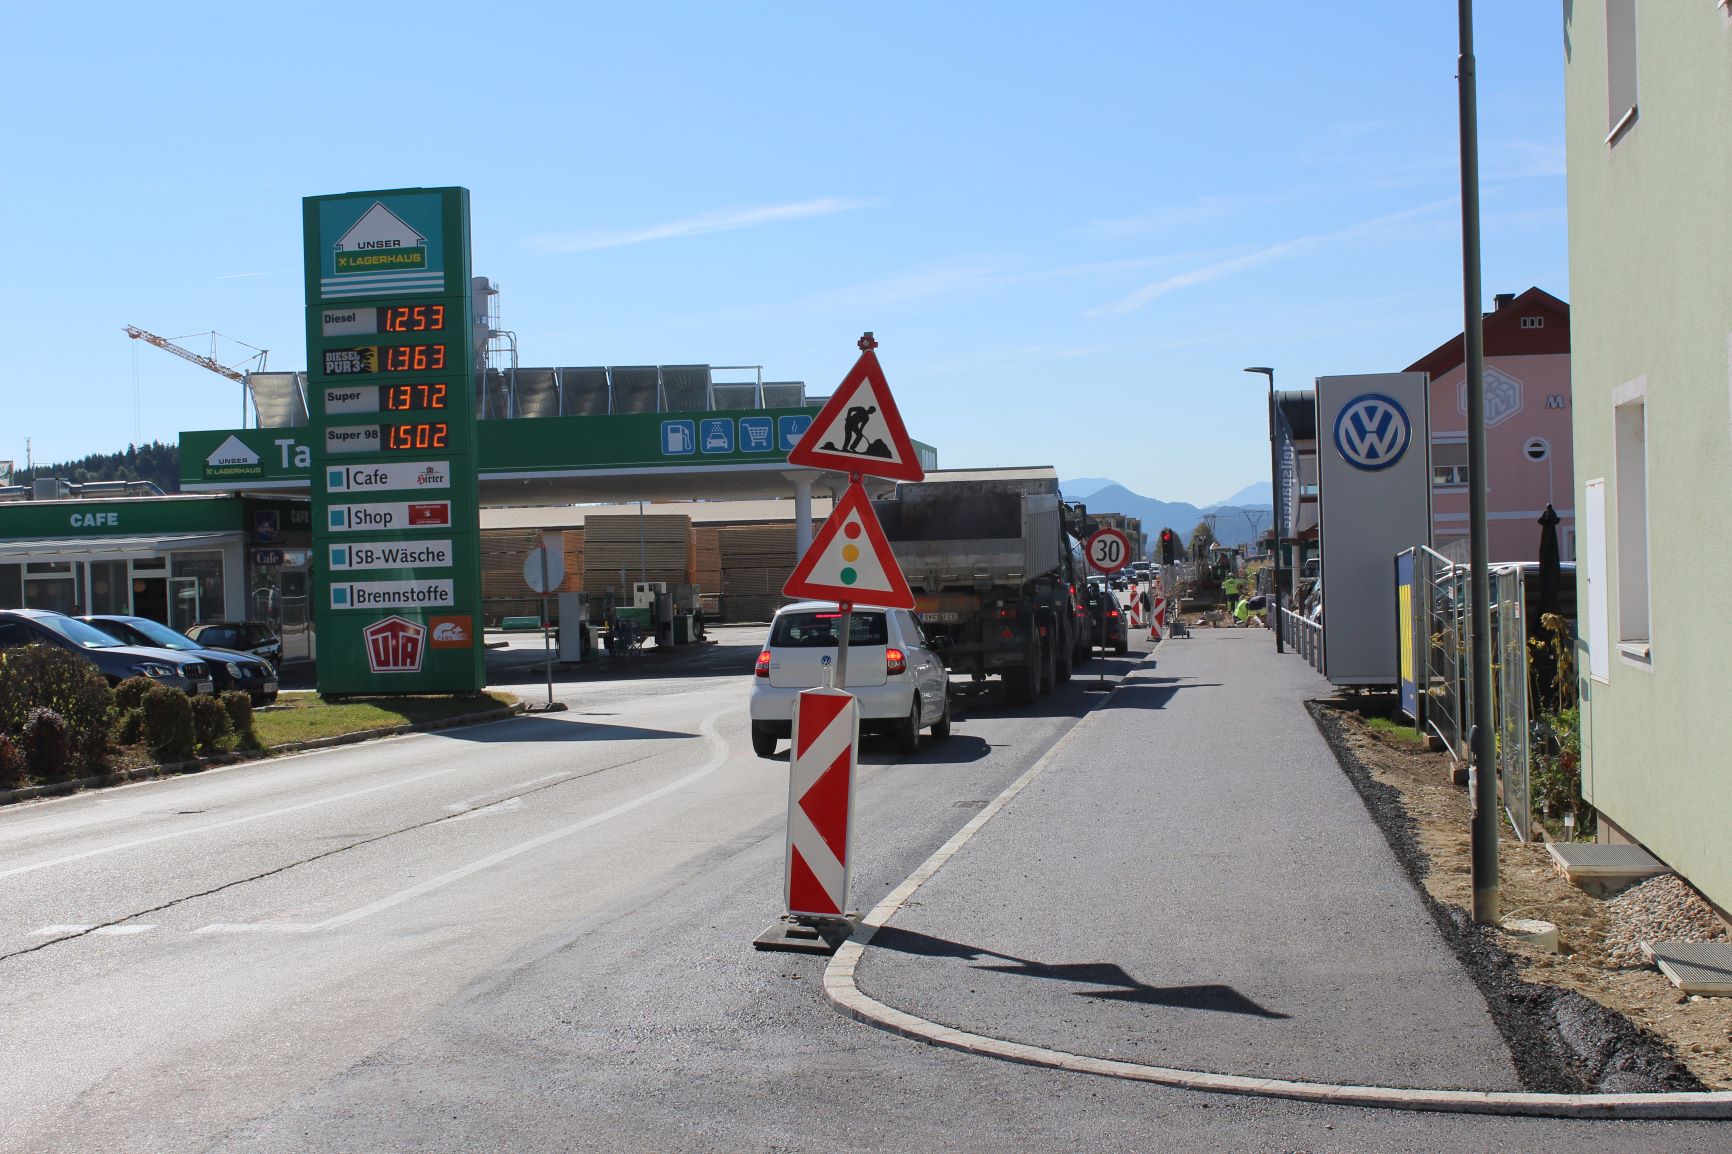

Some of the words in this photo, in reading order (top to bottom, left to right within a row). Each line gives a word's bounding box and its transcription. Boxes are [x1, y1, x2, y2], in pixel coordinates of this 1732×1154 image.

[357, 239, 401, 250] UNSER
[349, 253, 422, 267] LAGERHAUS
[324, 312, 356, 324] Diesel
[325, 351, 361, 362] DIESEL
[327, 391, 362, 404] Super
[327, 431, 362, 444] Super
[364, 430, 379, 441] 98
[218, 457, 248, 465] UNSER
[214, 467, 262, 475] LAGERHAUS
[353, 469, 389, 486] Cafe
[416, 473, 444, 485] Hirter
[70, 512, 118, 527] CAFE
[354, 509, 393, 528] Shop
[356, 546, 446, 565] SB-Wäsche
[1095, 539, 1121, 563] 30
[357, 586, 449, 604] Brennstoffe
[370, 620, 421, 668] UTA
